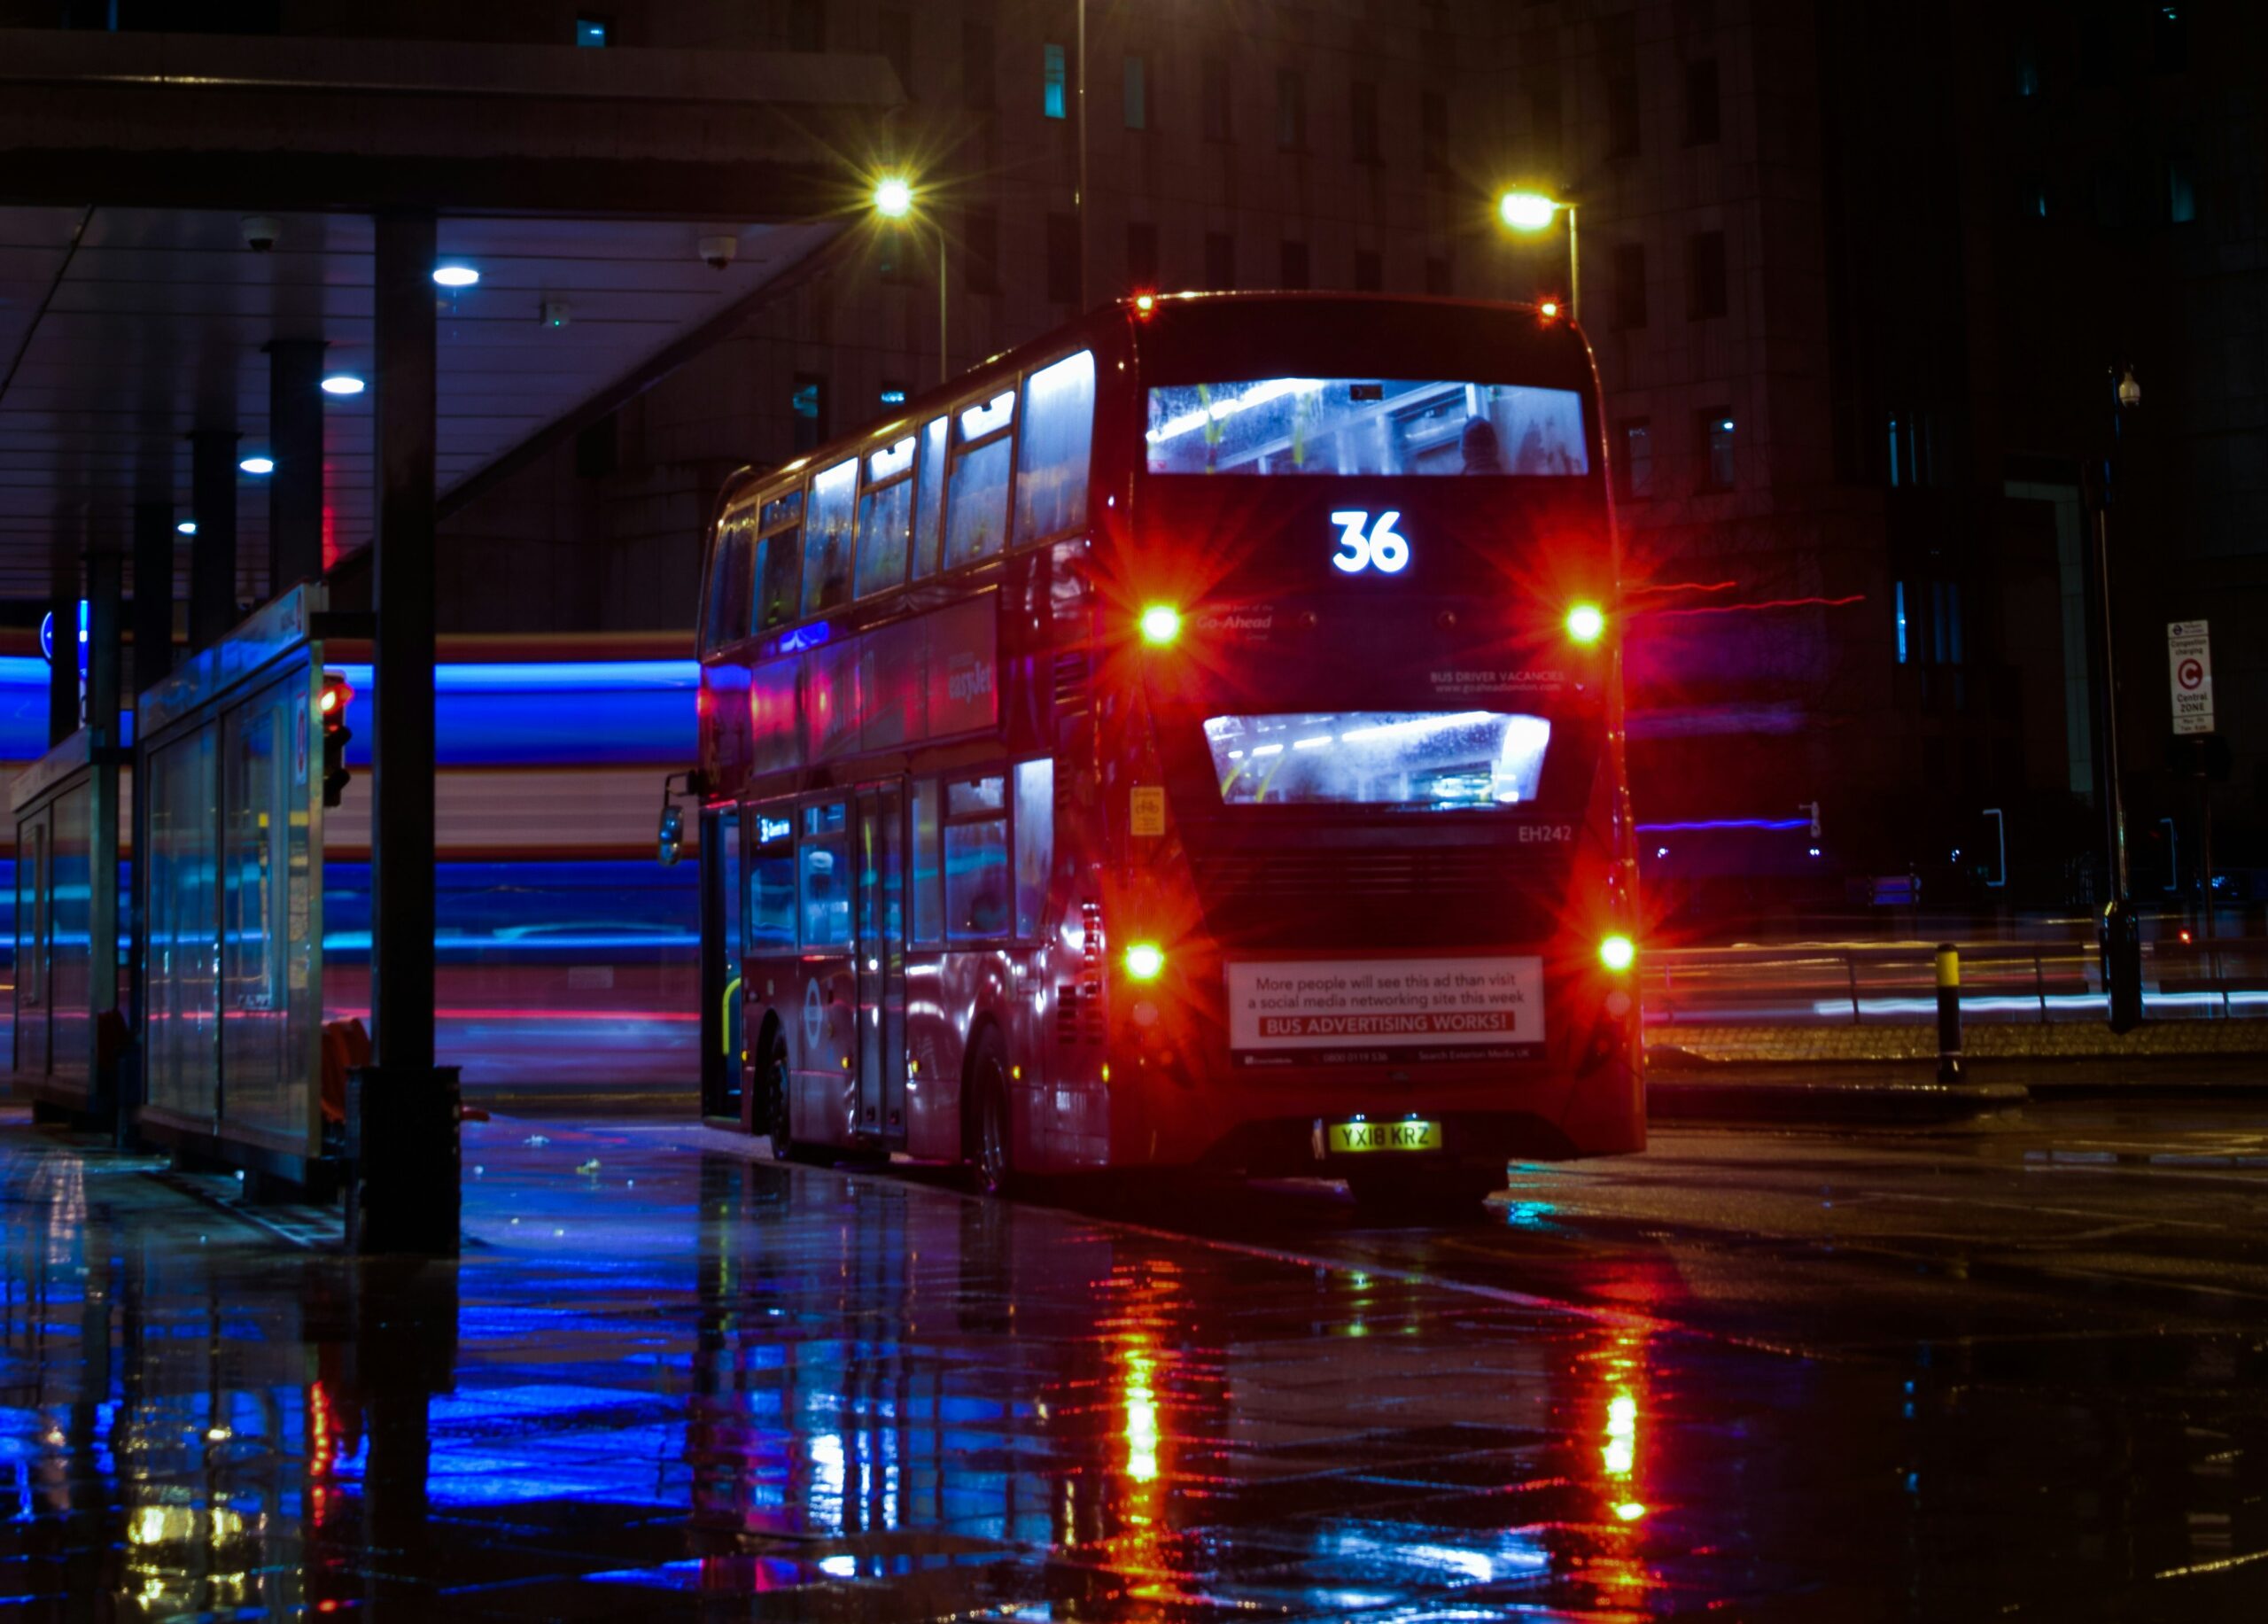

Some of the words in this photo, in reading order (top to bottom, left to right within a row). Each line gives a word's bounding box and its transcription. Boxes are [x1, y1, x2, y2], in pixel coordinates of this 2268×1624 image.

[1332, 511, 1409, 572] 36
[1196, 615, 1272, 629] Go-Ahead
[949, 659, 991, 703] easyJet
[1431, 672, 1453, 683] BUS
[1456, 672, 1495, 682] DRIVER
[1499, 671, 1565, 682] VACANCIES
[2177, 692, 2207, 703] Central
[2181, 703, 2204, 712] ZONE
[1518, 825, 1572, 843] EH242
[1256, 977, 1293, 991] More
[1298, 975, 1346, 993] people
[1350, 975, 1373, 989] will
[1378, 978, 1401, 989] see
[1405, 975, 1429, 988] this
[1433, 974, 1450, 987] ad
[1456, 974, 1485, 986] than
[1489, 973, 1516, 986] visit
[1248, 998, 1256, 1009] a
[1261, 995, 1299, 1009] social
[1303, 994, 1347, 1008] media
[1350, 991, 1428, 1009] networking
[1433, 992, 1456, 1006] site
[1461, 991, 1485, 1004] this
[1488, 990, 1524, 1004] week
[1266, 1018, 1301, 1035] BUS
[1307, 1015, 1428, 1034] ADVERTISING
[1433, 1013, 1506, 1031] WORKS!
[1418, 1050, 1448, 1061] Search
[1517, 1048, 1530, 1059] UK
[1391, 1126, 1430, 1145] KRZ
